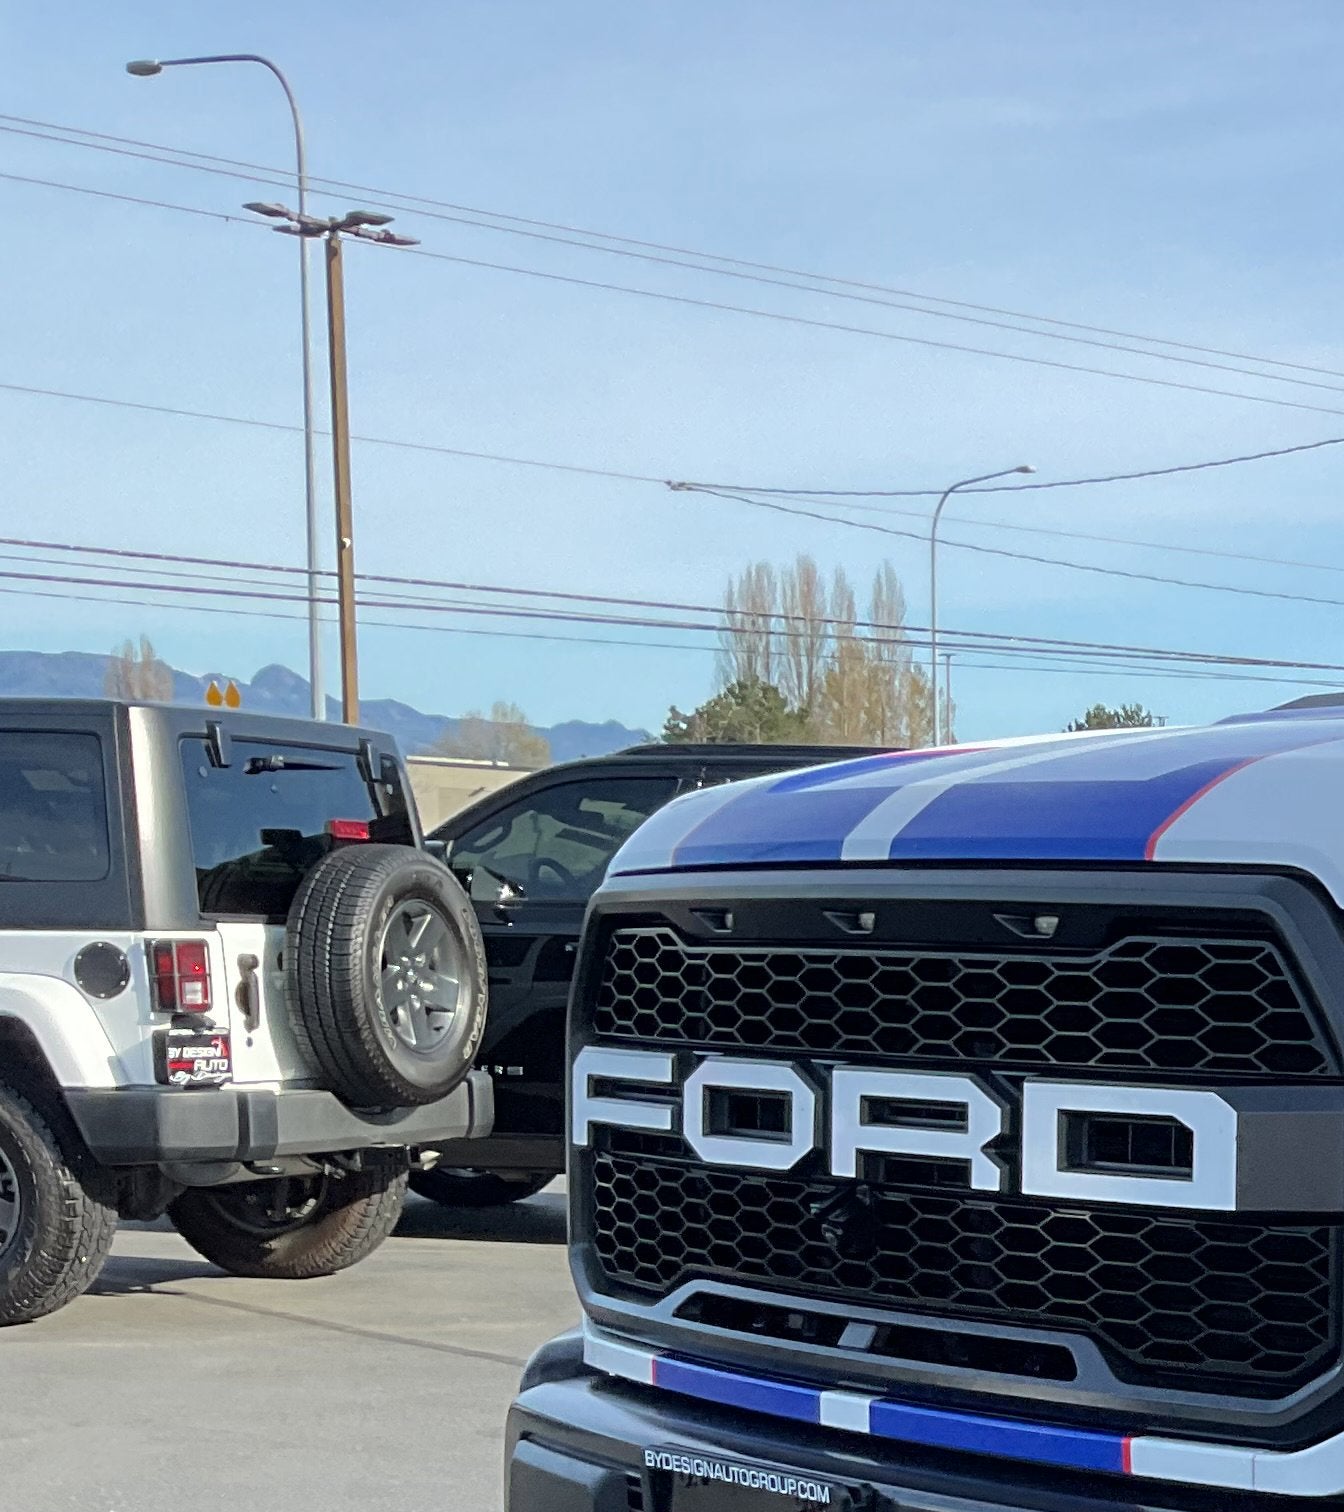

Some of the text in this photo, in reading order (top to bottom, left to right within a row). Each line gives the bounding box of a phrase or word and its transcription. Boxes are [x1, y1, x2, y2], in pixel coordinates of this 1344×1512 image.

[193, 1059, 229, 1071] AUTO
[572, 1045, 1238, 1212] FORD
[644, 1450, 830, 1504] BYDESIGNAUTOGROUP.COM
